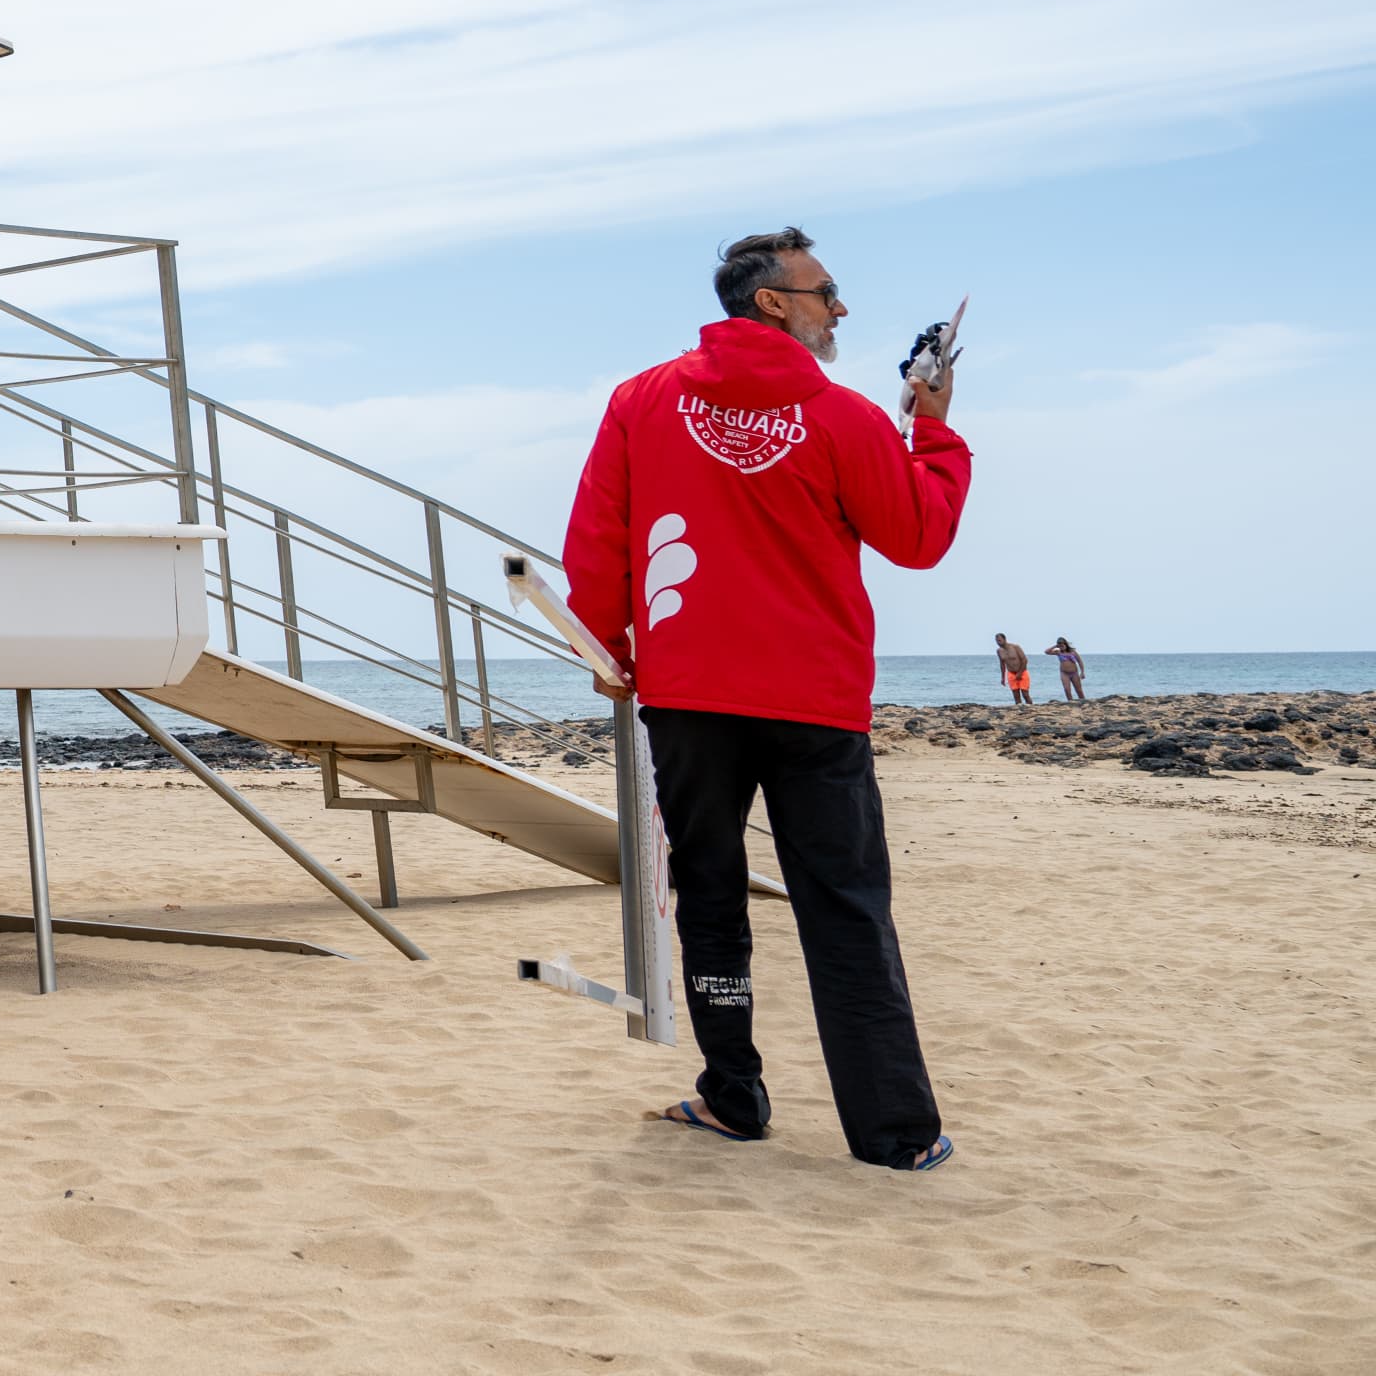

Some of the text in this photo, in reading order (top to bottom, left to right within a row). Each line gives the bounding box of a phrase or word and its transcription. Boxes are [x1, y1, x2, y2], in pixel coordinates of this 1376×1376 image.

[677, 394, 807, 444] LIFEGUARD
[696, 421, 781, 466] SOCORISTA
[722, 437, 749, 449] SAFETY
[725, 430, 749, 441] BEACH
